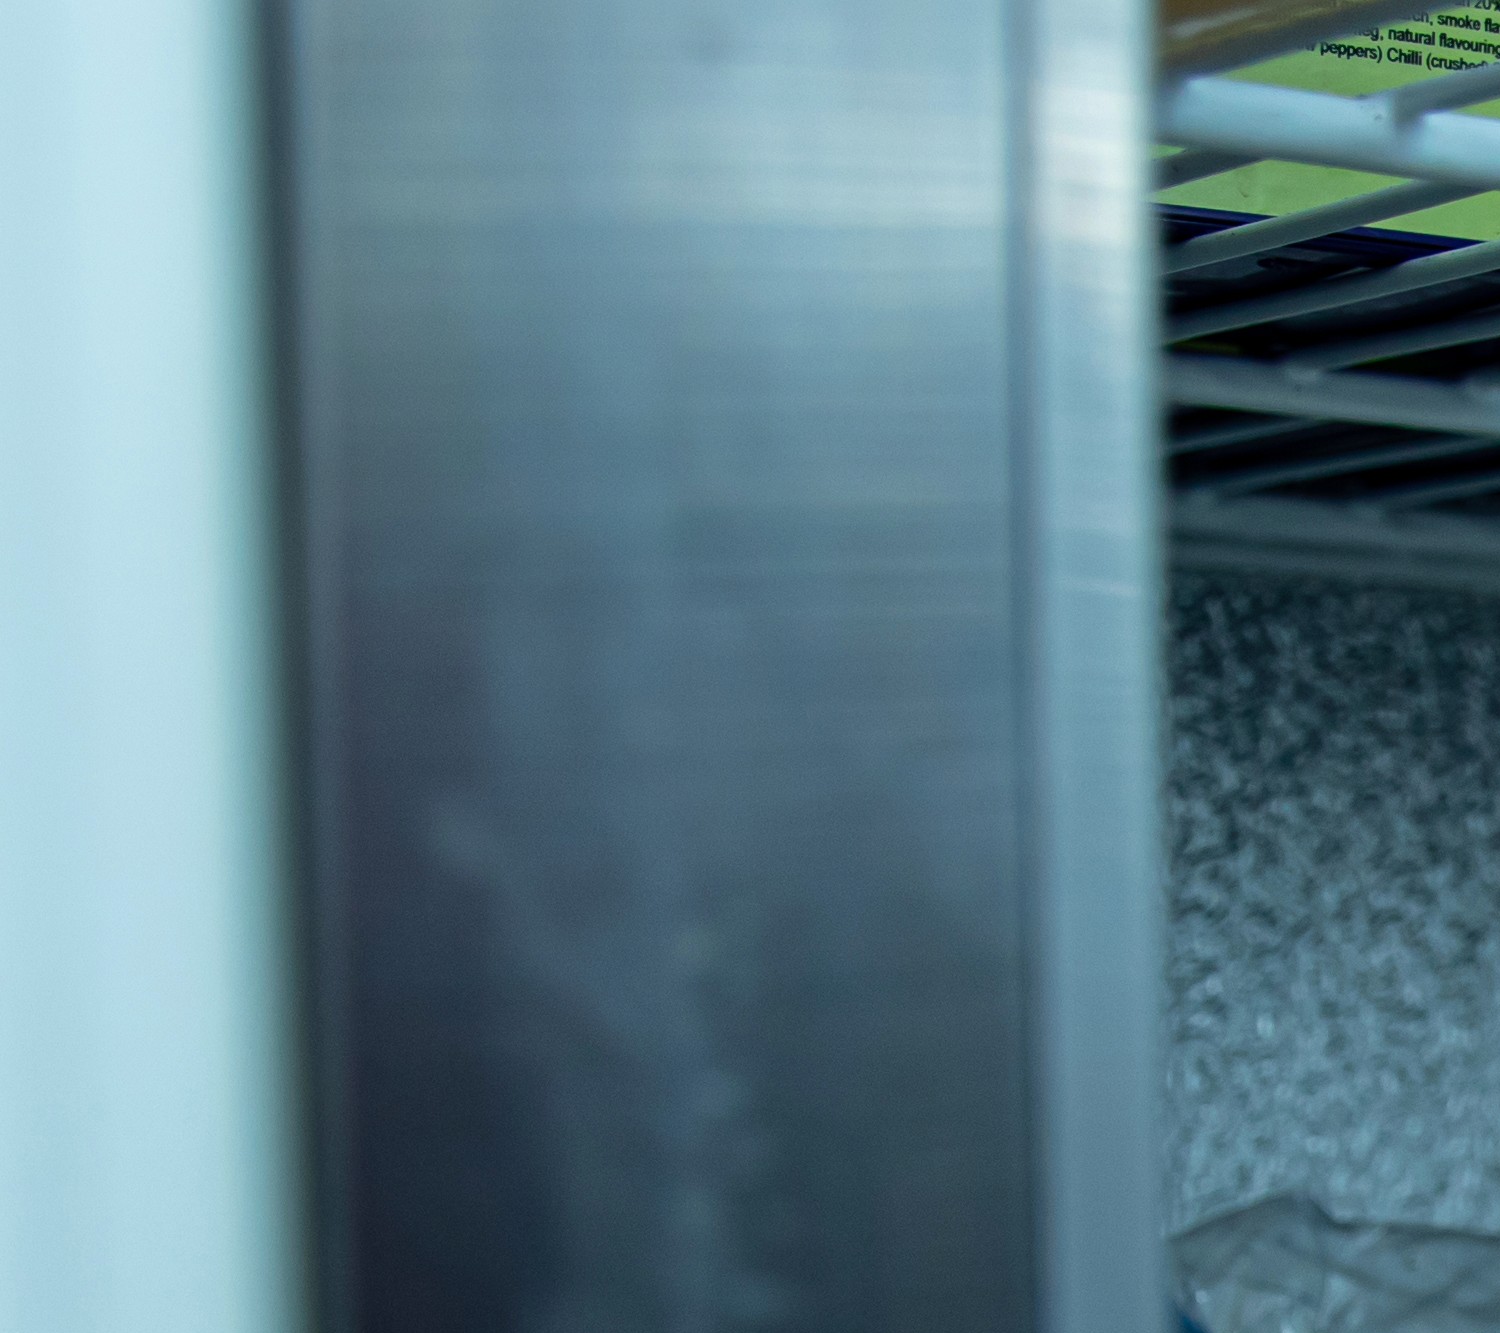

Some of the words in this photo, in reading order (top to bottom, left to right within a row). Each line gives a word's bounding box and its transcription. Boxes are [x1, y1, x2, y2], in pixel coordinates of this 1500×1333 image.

[1437, 14, 1481, 31] smoke
[1388, 28, 1435, 46] natural
[1320, 41, 1382, 63] peppers)
[1387, 47, 1422, 66] Chilli
